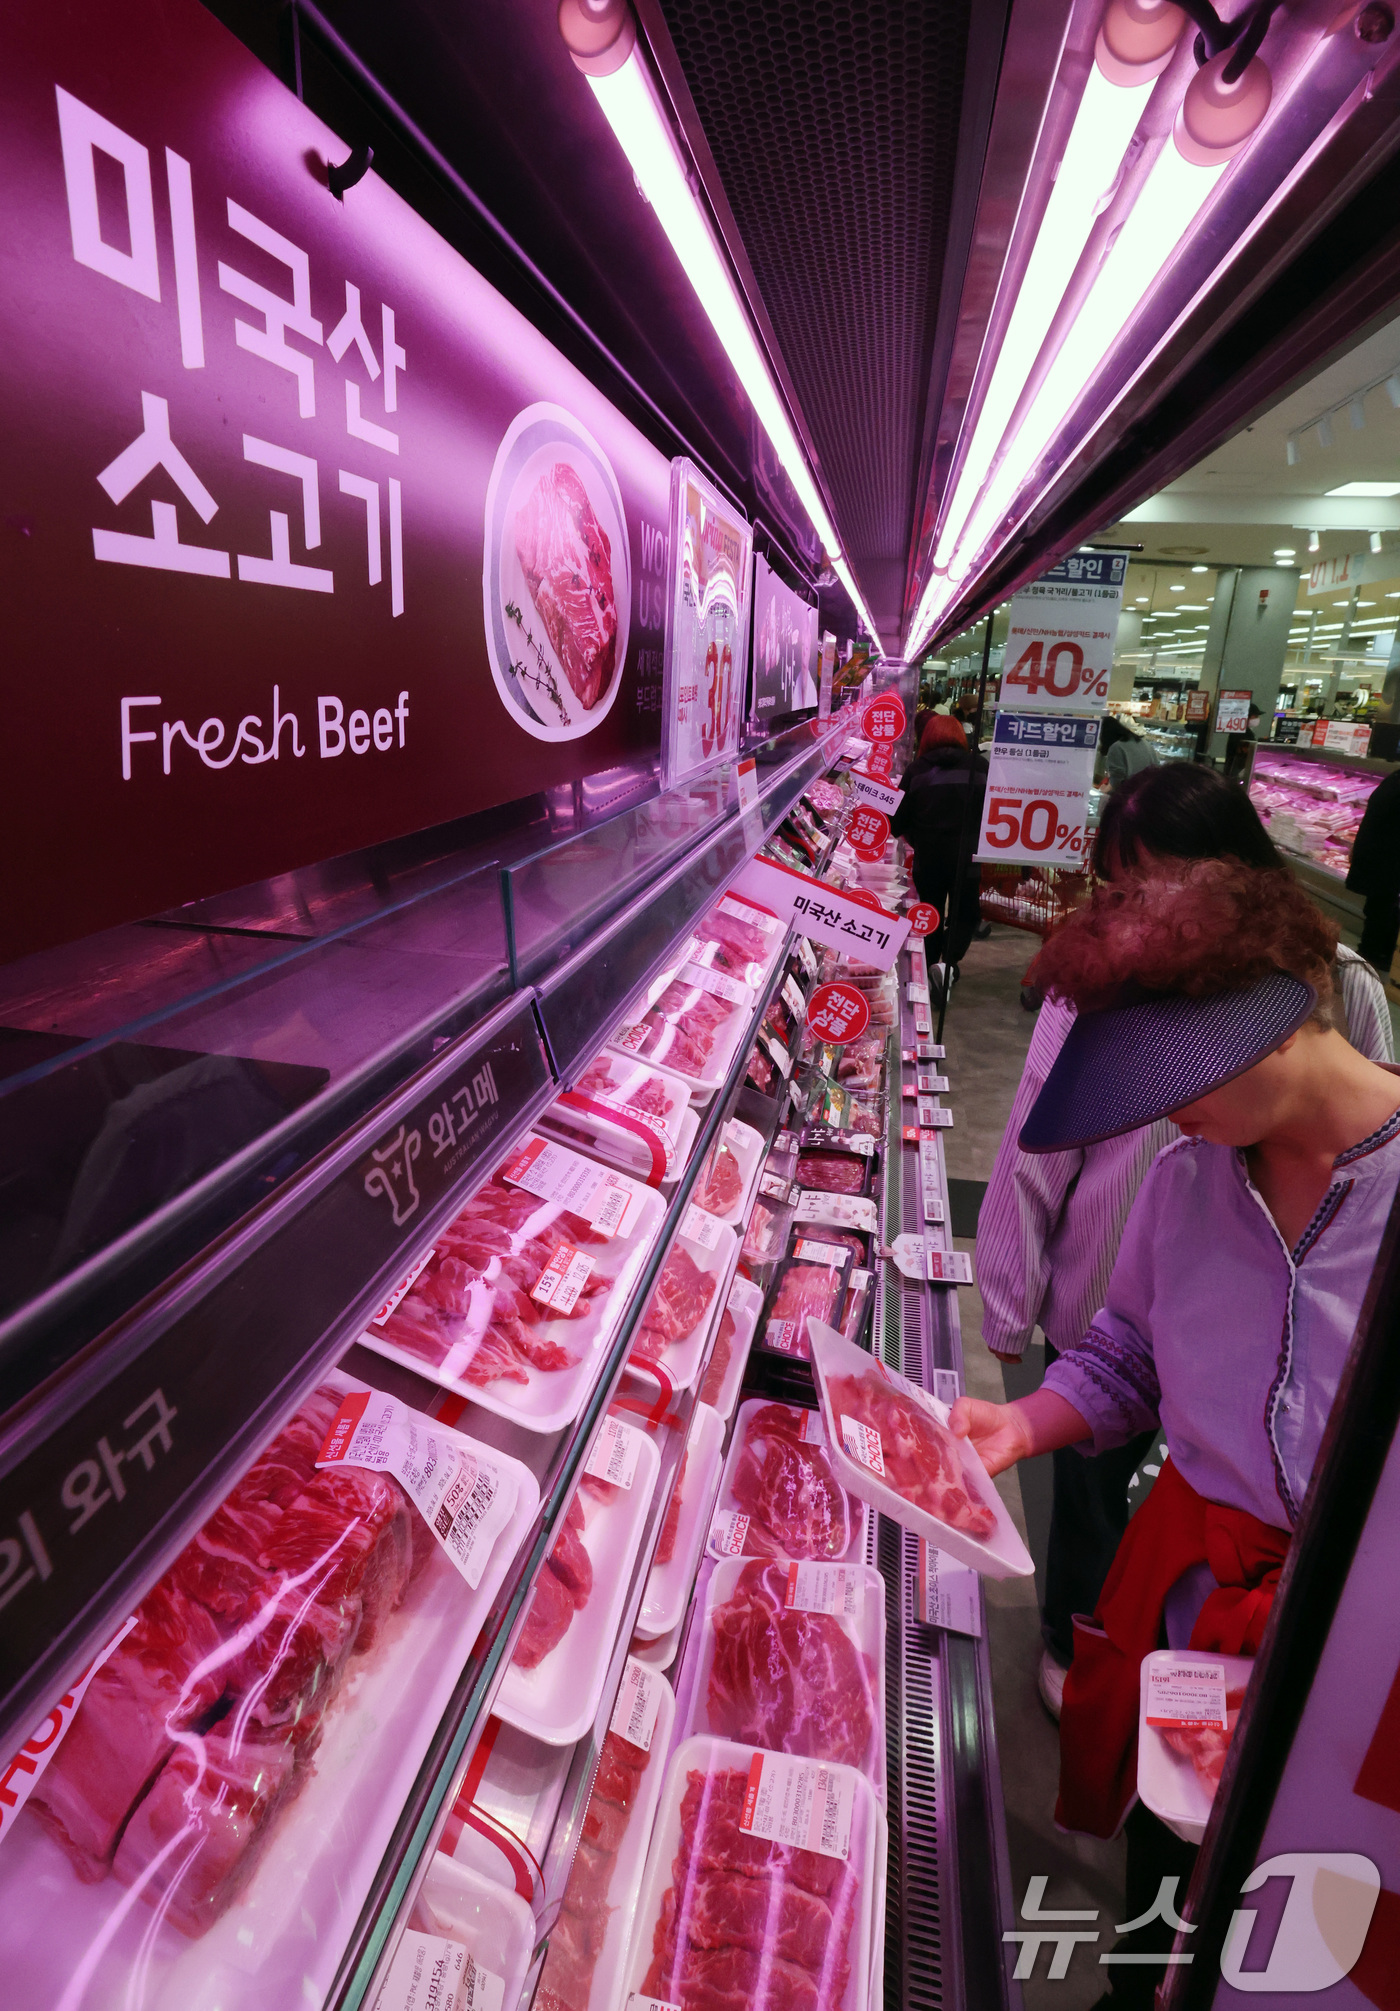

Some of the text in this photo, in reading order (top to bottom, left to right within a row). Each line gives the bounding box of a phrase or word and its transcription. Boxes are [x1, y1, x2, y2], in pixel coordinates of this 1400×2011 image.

[55, 84, 406, 456] 미국산
[92, 391, 404, 618] 소고기
[1048, 558, 1103, 579] 드할인
[1006, 641, 1107, 697] 40%
[872, 710, 895, 723] 전단
[1216, 717, 1247, 731] 1,490
[121, 685, 409, 780] Fresh Beef
[872, 725, 895, 736] 상품
[1008, 721, 1077, 742] 카드할인
[994, 747, 1049, 758] 한우 등심 (1등급)
[854, 781, 895, 805] 테이크 345
[857, 813, 882, 832] 전단
[986, 798, 1082, 852] 50%
[851, 827, 875, 845] 상품
[793, 895, 842, 928] 미국산
[840, 917, 890, 949] 소고기
[827, 991, 860, 1021] 전단
[621, 1022, 648, 1047] CHOICE
[814, 1008, 846, 1037] 상품
[428, 1061, 499, 1158] 와고메
[536, 1272, 556, 1294] 15%
[779, 1321, 793, 1349] CHOICE
[326, 1438, 344, 1459] 신선을
[865, 1427, 881, 1471] CHOICE
[61, 1387, 178, 1535] 와규
[447, 1483, 464, 1507] 50%
[729, 1515, 748, 1554] CHOICE
[928, 1602, 938, 1623] 미국산
[744, 1808, 752, 1826] 신선을
[452, 1951, 464, 1970] 646
